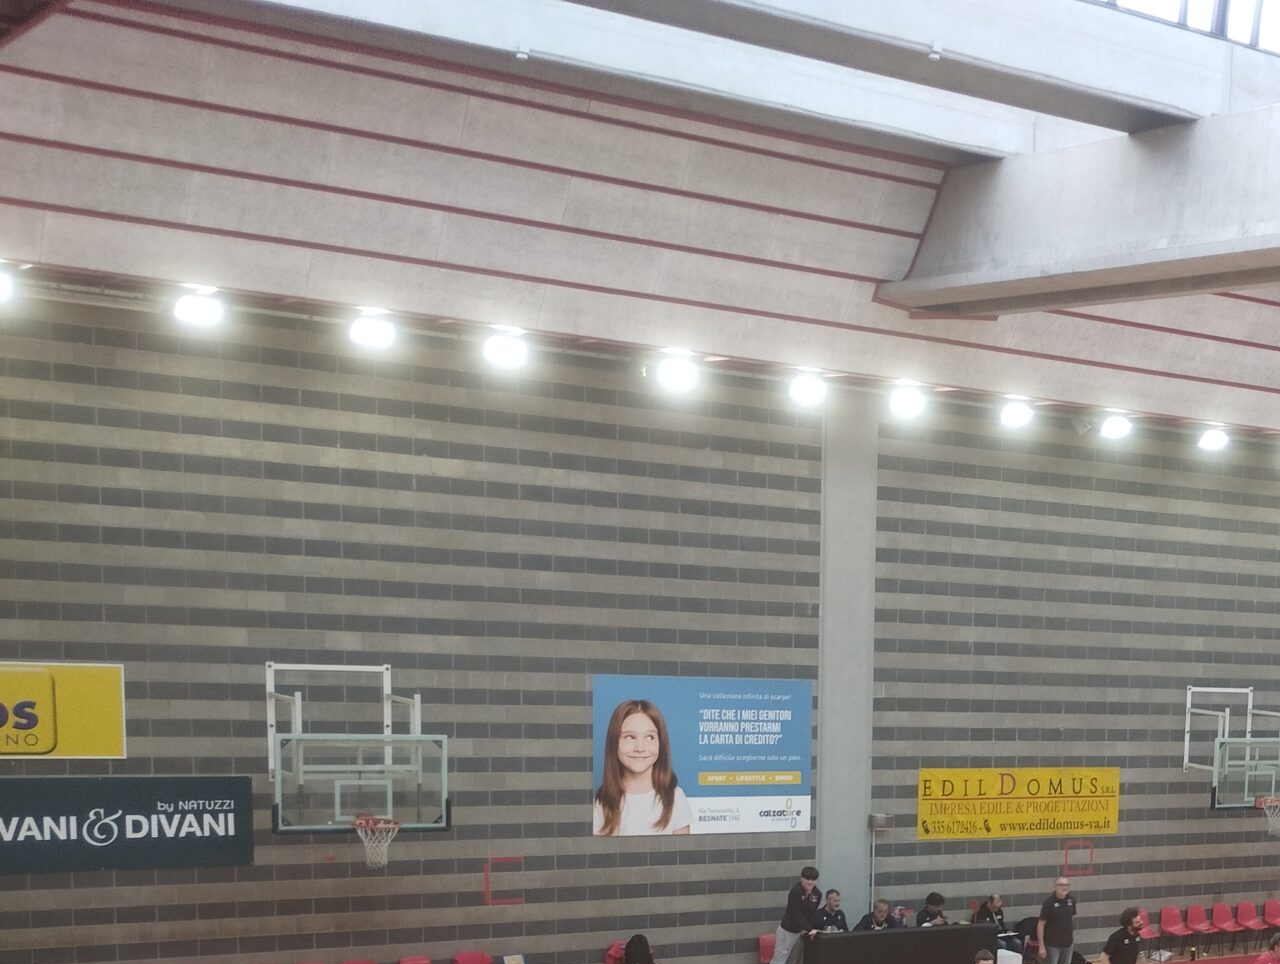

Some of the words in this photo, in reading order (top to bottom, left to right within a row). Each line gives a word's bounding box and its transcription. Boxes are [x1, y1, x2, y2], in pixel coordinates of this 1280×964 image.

[721, 709, 737, 721] CHE
[741, 709, 758, 721] MIEI
[758, 709, 792, 721] GENITORI
[699, 721, 739, 733] VORRANNO
[740, 721, 781, 733] PRESTARMI
[698, 734, 709, 745] LA
[709, 734, 734, 745] CARTA
[735, 734, 743, 745] DI
[157, 801, 174, 812] by
[178, 800, 235, 810] NATUZZI
[930, 802, 977, 816] IMPRESA
[980, 801, 1013, 815] EDILE
[1015, 801, 1024, 814] &
[1026, 799, 1109, 814] PROGETTAZIONI
[82, 808, 123, 847] &
[125, 813, 236, 839] DIVANI
[931, 821, 945, 834] 335
[1000, 817, 1110, 832] www.edildomus-va.it
